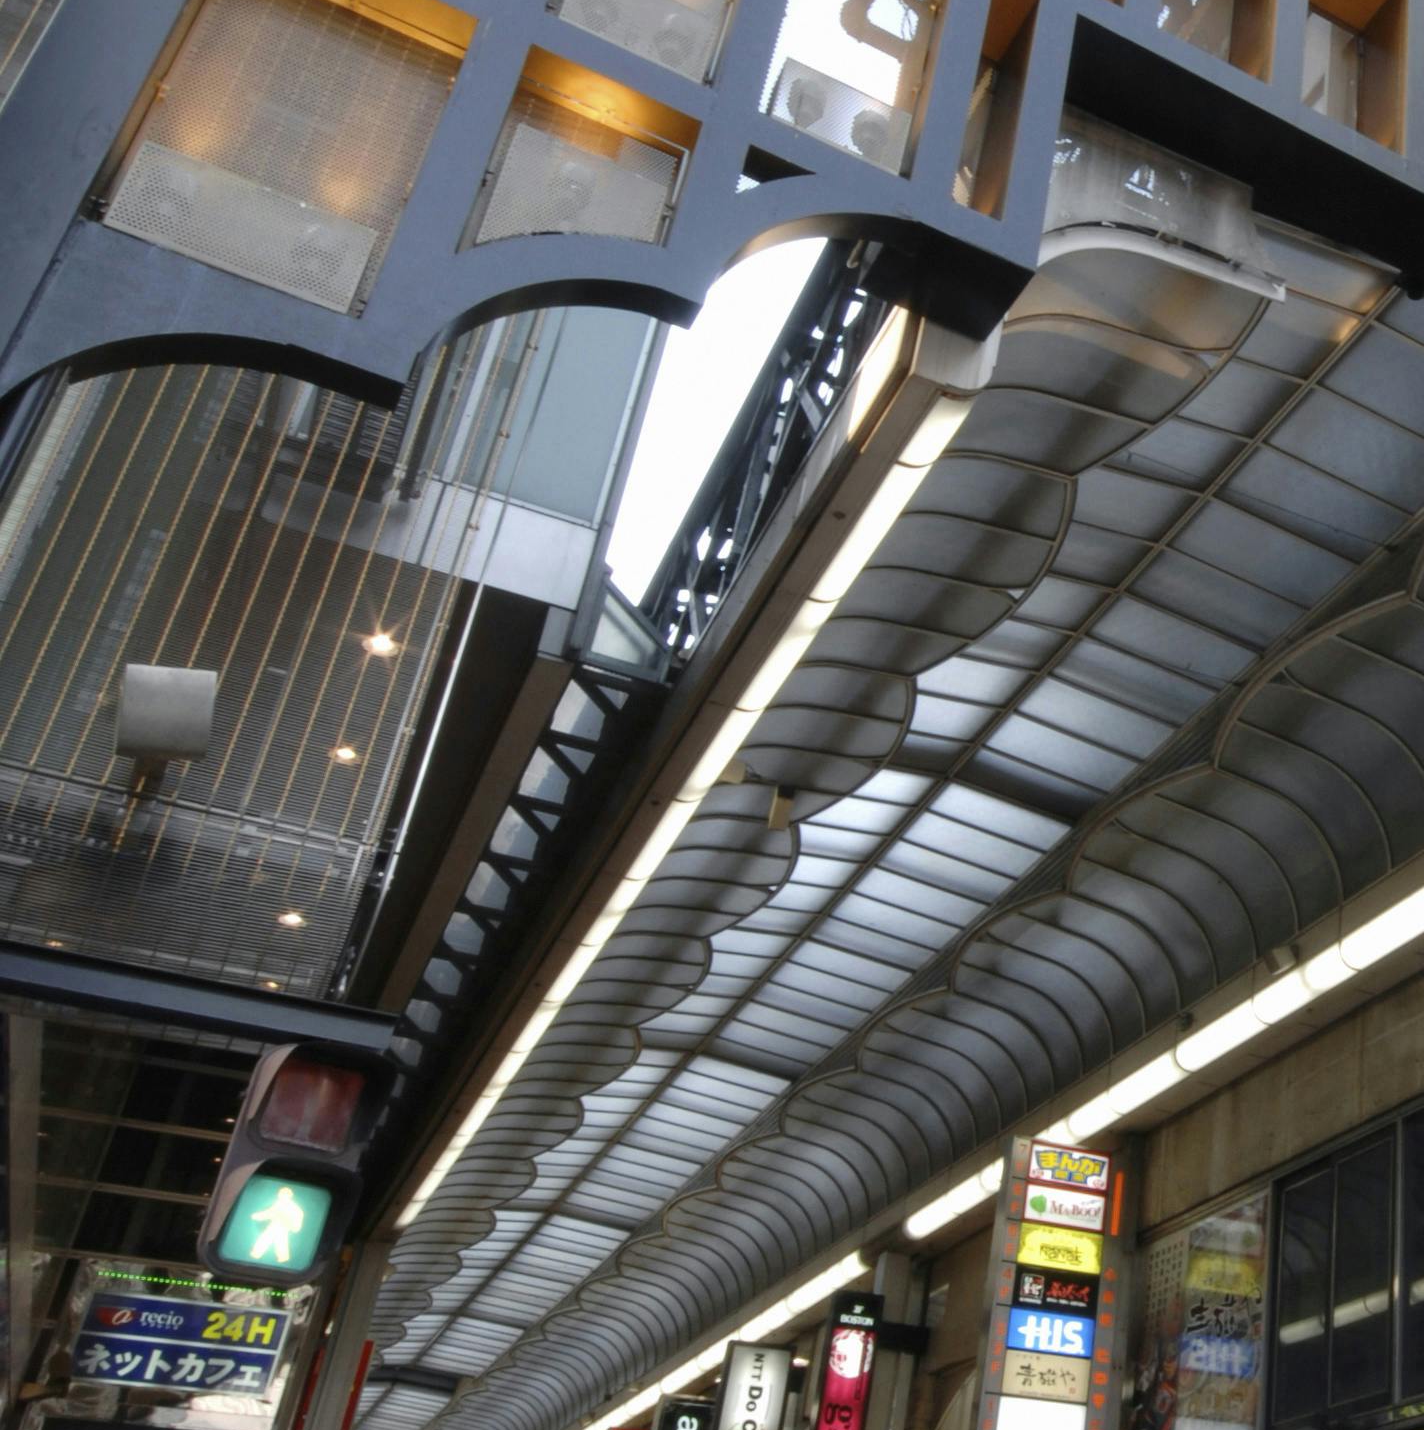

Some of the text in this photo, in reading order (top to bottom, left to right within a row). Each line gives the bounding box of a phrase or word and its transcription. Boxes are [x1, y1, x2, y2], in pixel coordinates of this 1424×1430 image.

[202, 1311, 277, 1345] 24H
[79, 1343, 263, 1388] ネットカフェ
[750, 1353, 766, 1381] NTT
